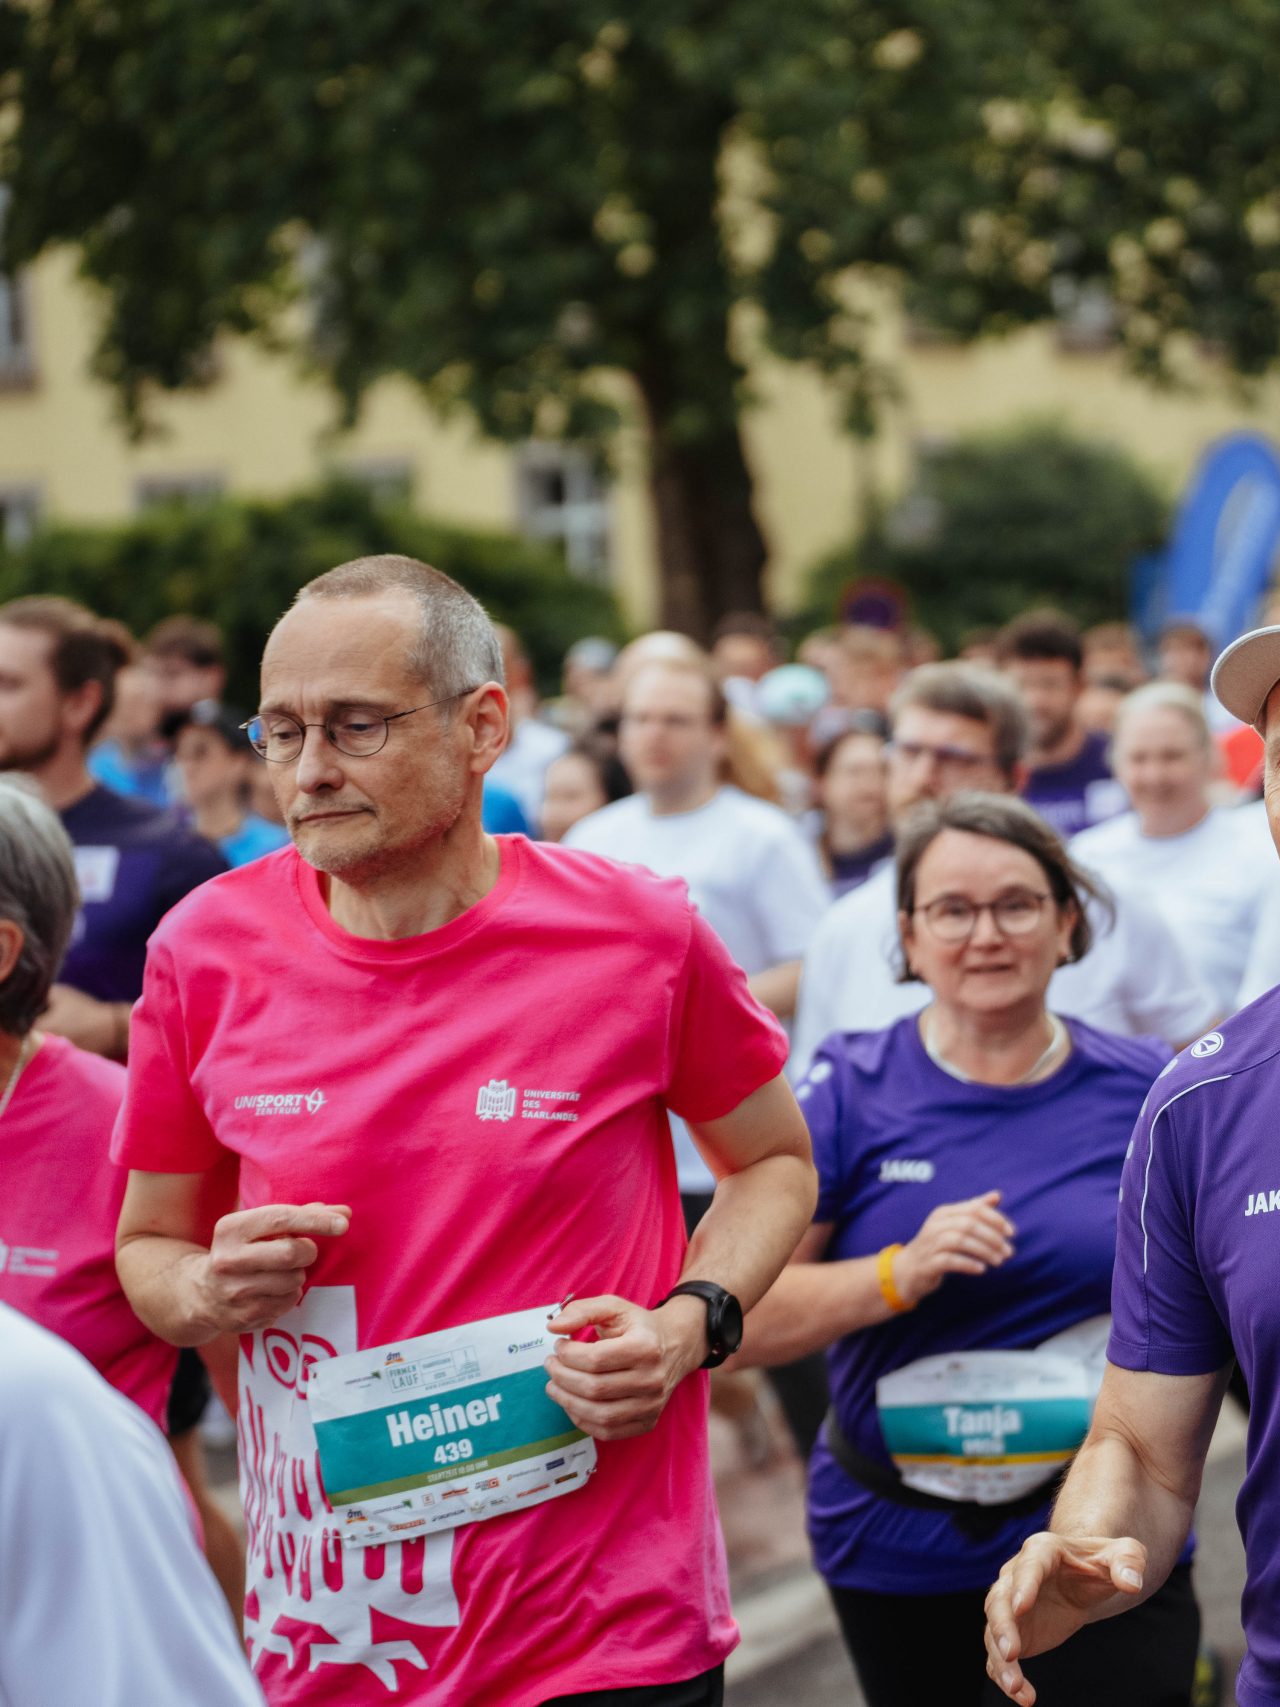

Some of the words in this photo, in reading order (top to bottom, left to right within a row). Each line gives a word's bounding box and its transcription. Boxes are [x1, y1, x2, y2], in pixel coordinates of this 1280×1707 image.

[234, 1094, 304, 1110] UNISPORT
[522, 1100, 541, 1109] DES
[255, 1107, 301, 1116] ZENTRUM
[521, 1110, 579, 1122] SAARLANDES
[878, 1159, 935, 1183] JAKO
[385, 1351, 401, 1362] dm
[389, 1365, 418, 1378] FIRMEN
[392, 1374, 419, 1390] LAUF
[386, 1393, 502, 1448] Heiner
[943, 1405, 1022, 1439] Tanja
[434, 1438, 473, 1464] 439
